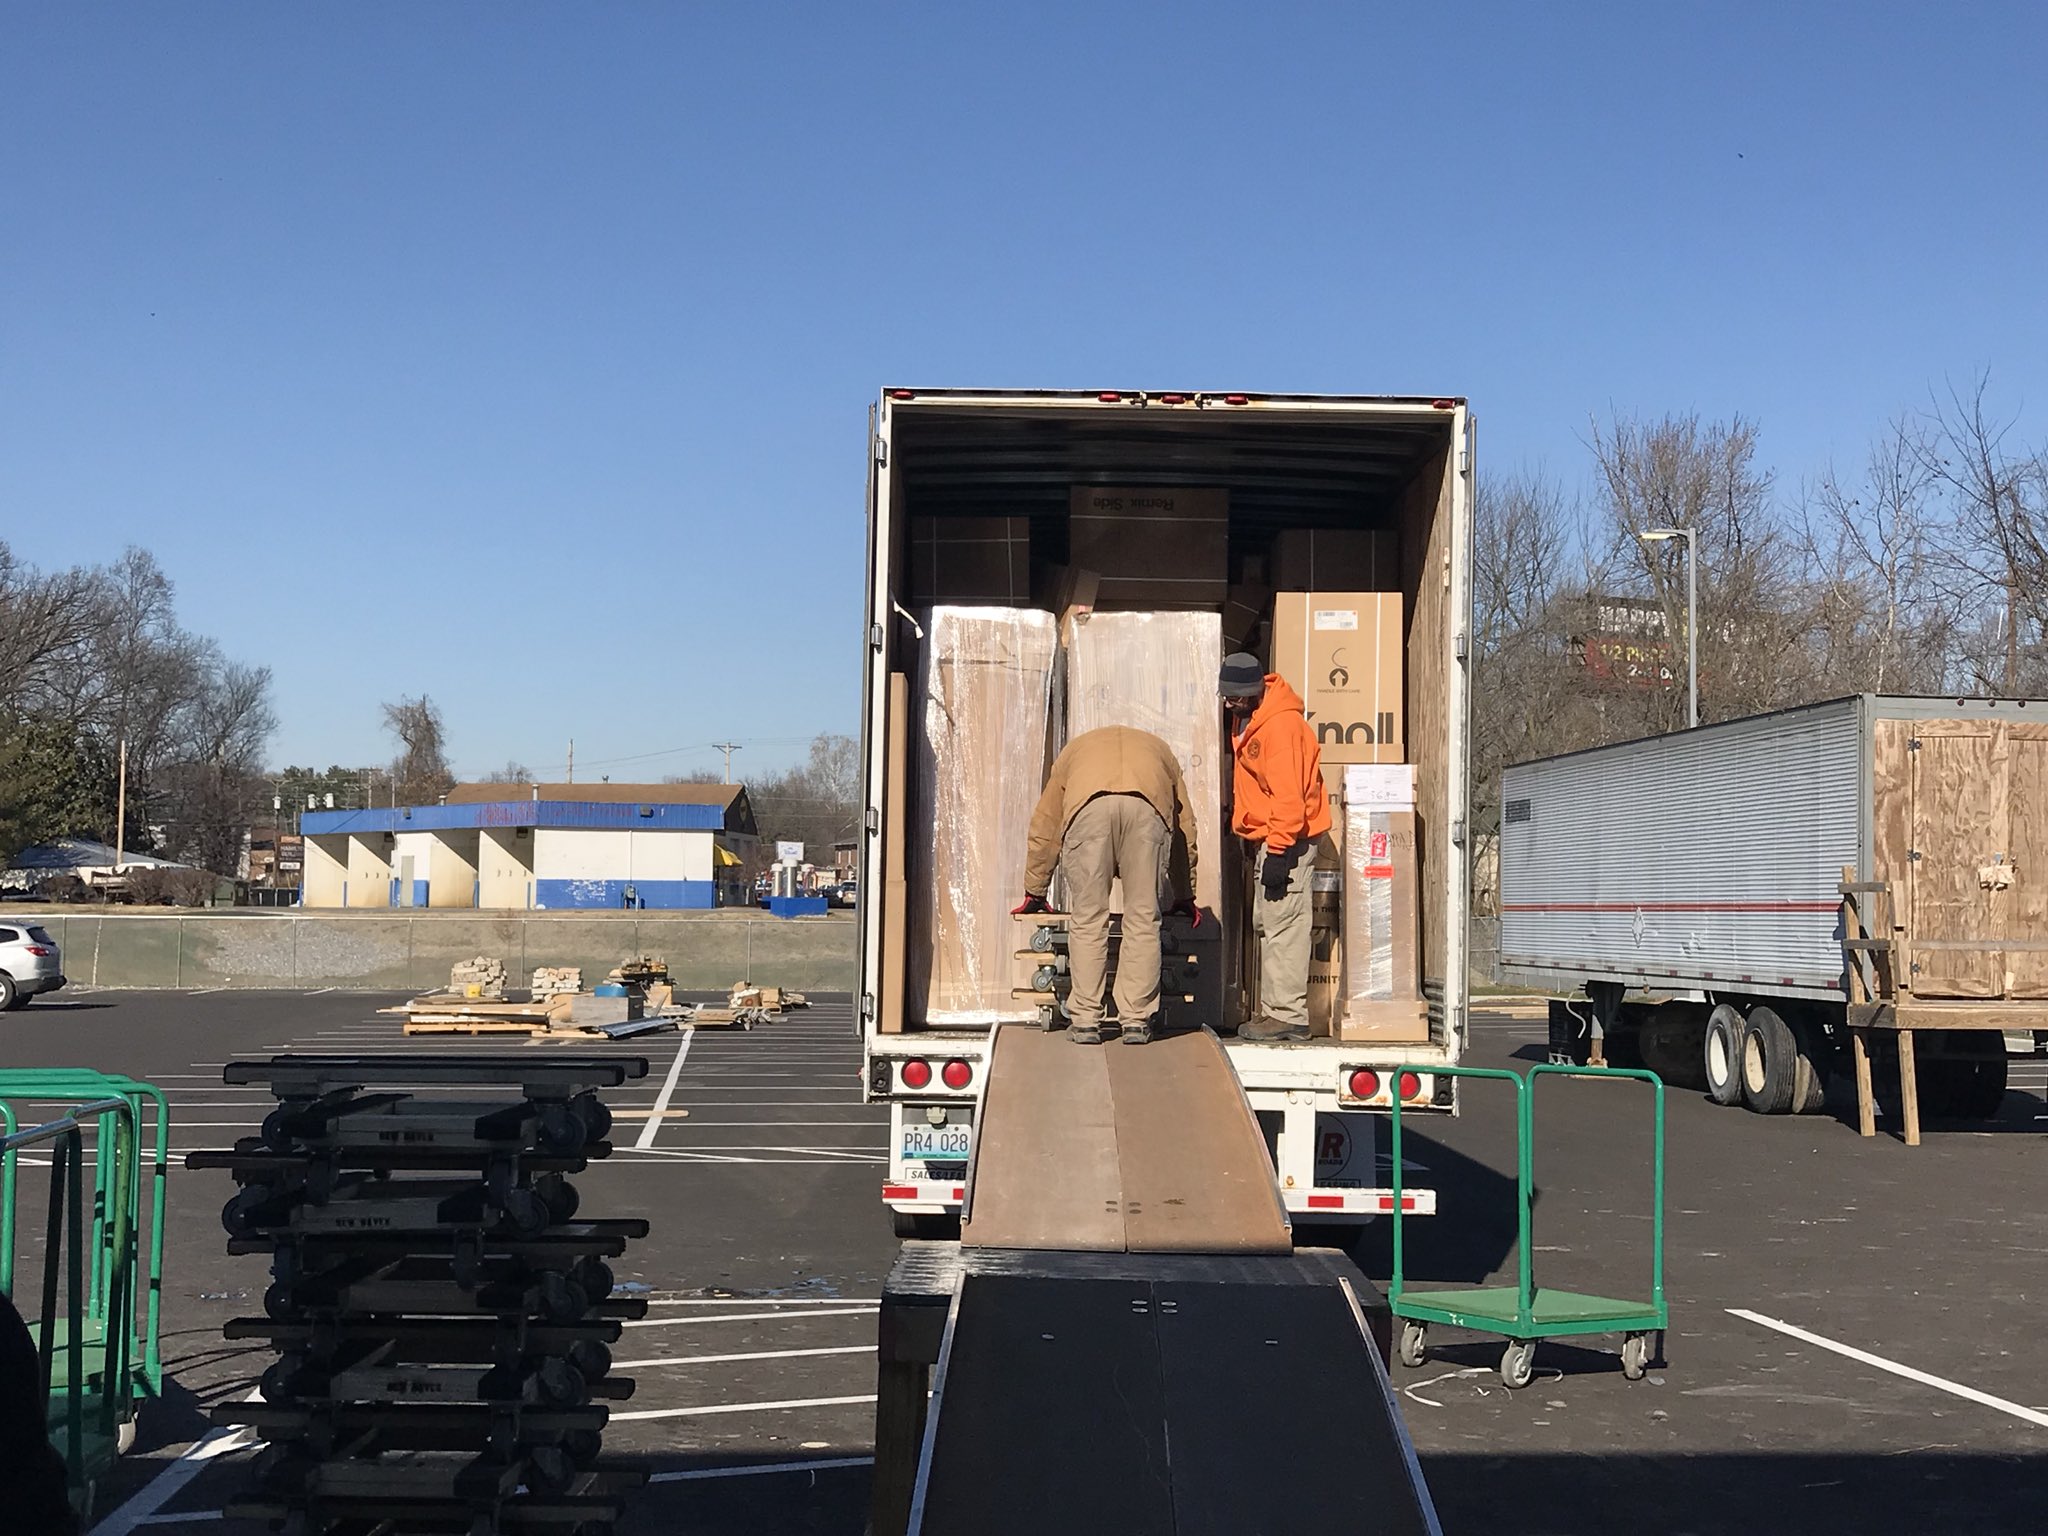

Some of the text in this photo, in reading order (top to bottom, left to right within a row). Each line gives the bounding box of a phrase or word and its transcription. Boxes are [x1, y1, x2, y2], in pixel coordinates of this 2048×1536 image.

[1093, 498, 1123, 511] Side
[1306, 712, 1394, 744] noll
[904, 1132, 969, 1152] PR4 028
